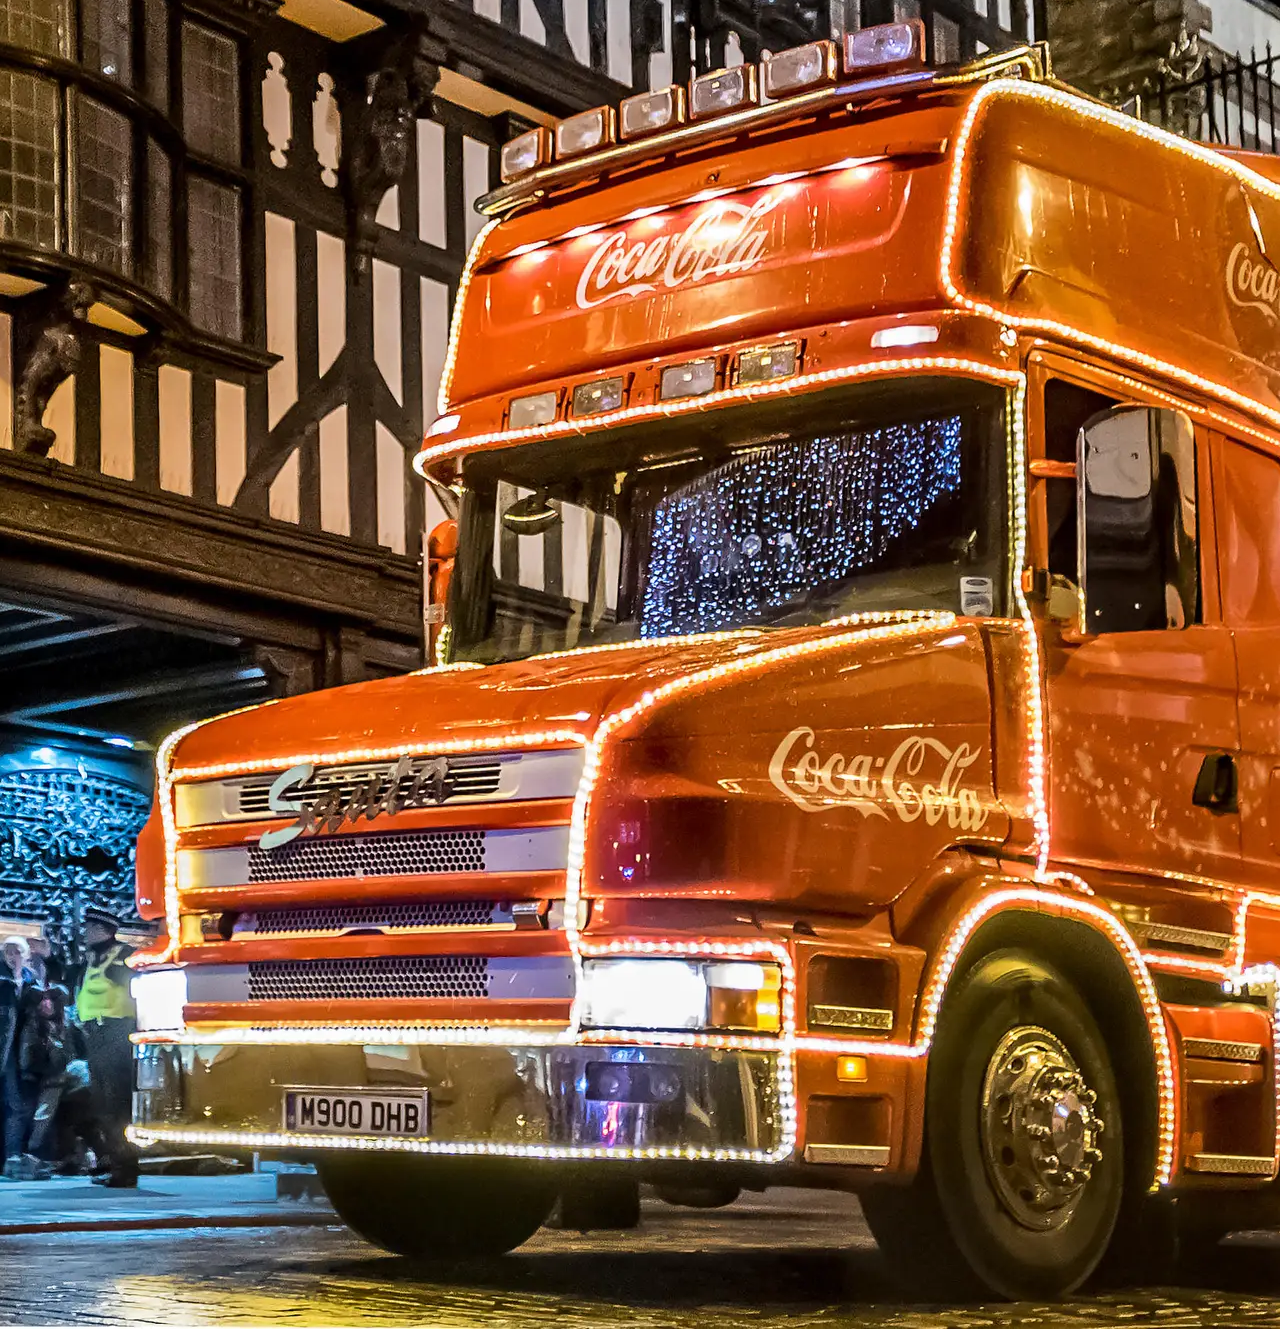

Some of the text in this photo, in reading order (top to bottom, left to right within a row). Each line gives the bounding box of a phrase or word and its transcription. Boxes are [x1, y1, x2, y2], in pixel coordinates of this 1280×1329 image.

[576, 192, 782, 309] Coca-Cola
[259, 753, 458, 850] Santa
[768, 725, 988, 832] Coca-Cola
[300, 1097, 419, 1133] M900 DHB
